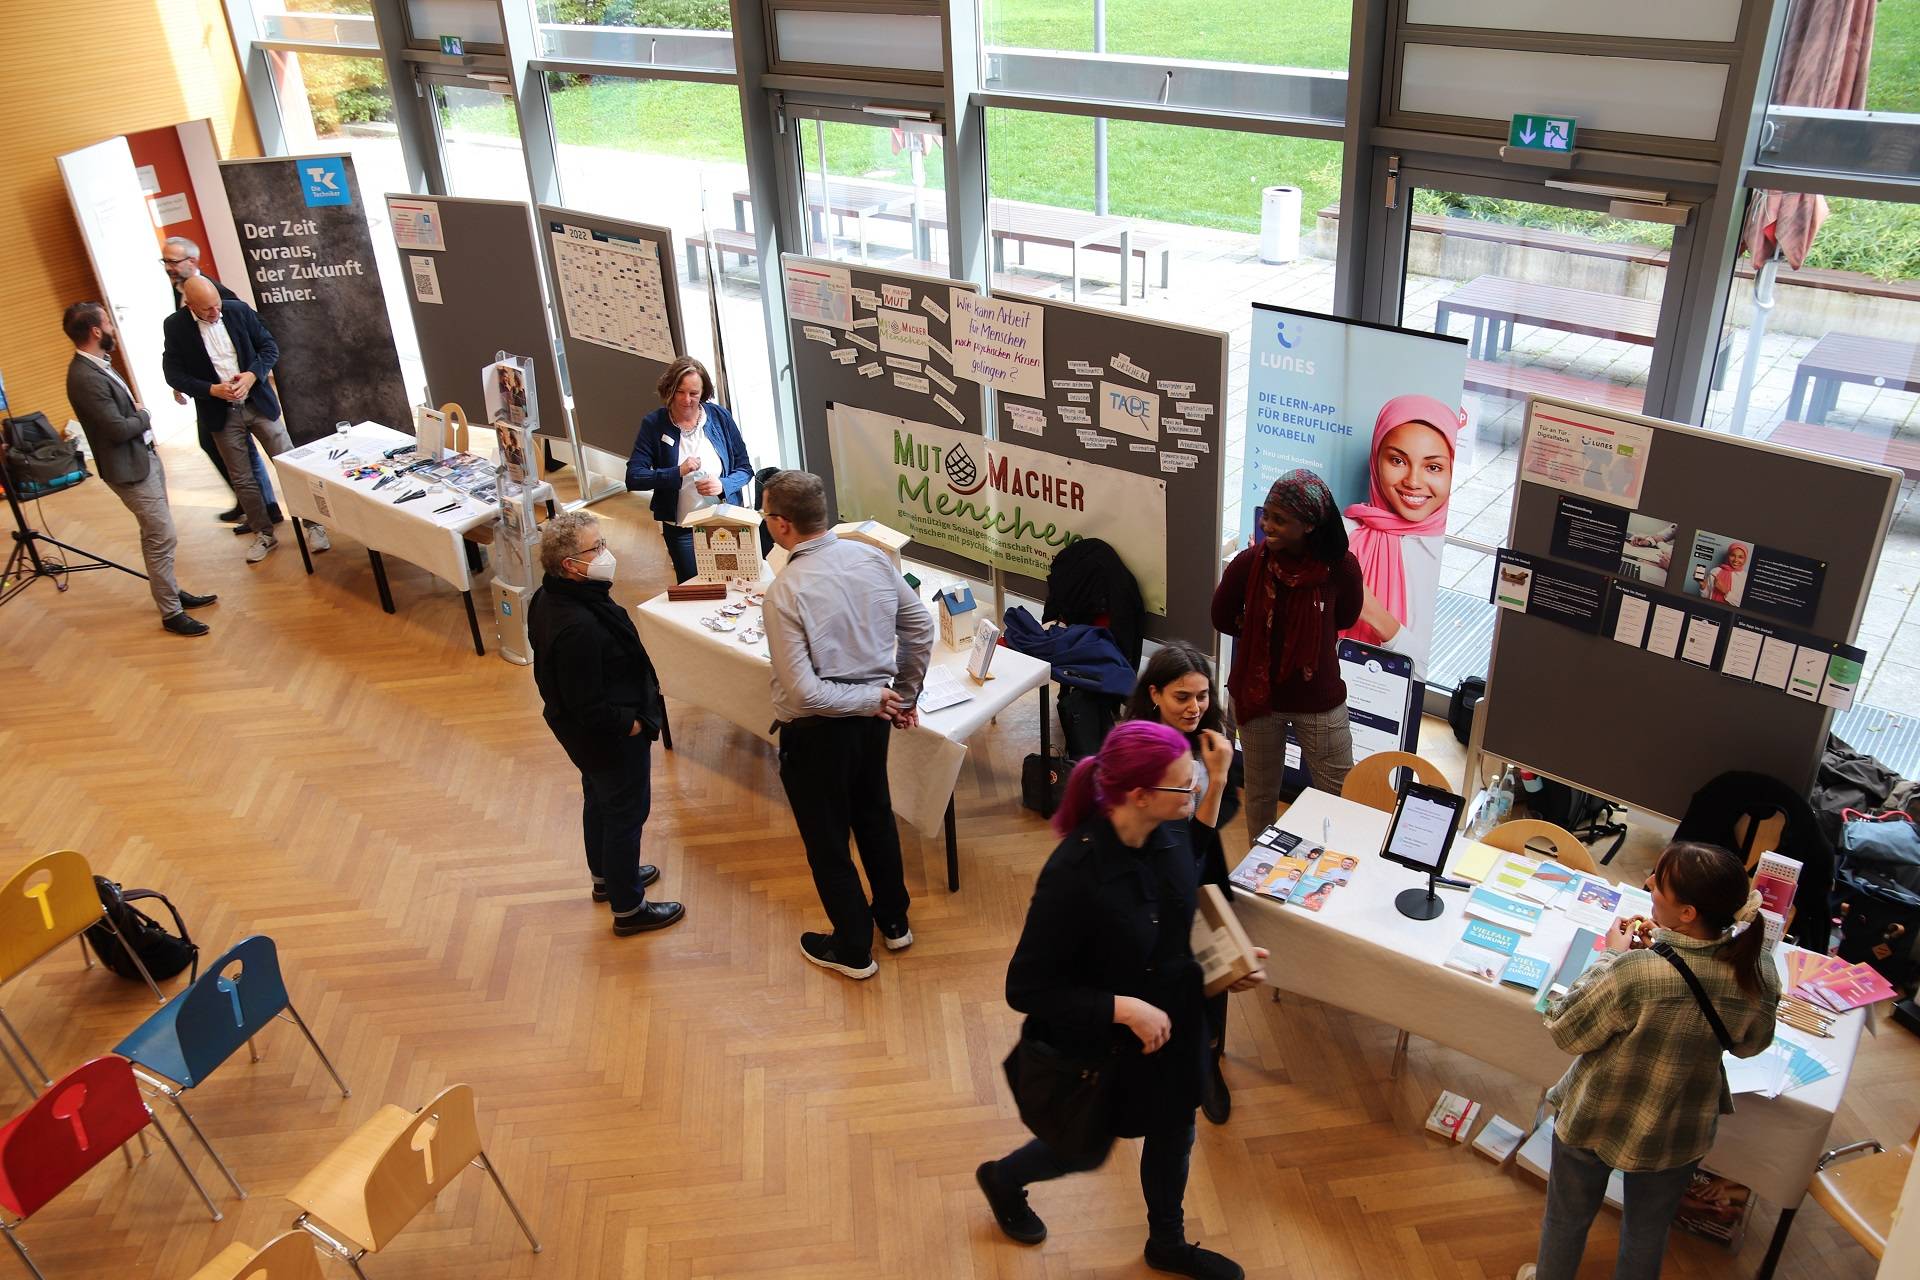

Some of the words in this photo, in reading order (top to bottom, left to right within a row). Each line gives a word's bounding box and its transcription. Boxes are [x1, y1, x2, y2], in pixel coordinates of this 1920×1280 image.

[306, 167, 339, 190] TK
[244, 222, 276, 240] Der
[280, 219, 319, 236] Zeit
[250, 245, 317, 261] voraus,
[256, 263, 284, 283] der
[289, 260, 363, 280] Zukunft
[260, 286, 316, 304] näher.
[884, 295, 905, 308] MUT
[957, 295, 972, 312] Wie
[974, 302, 995, 320] kann
[997, 307, 1031, 328] Arbeit
[879, 330, 930, 346] Menschen
[901, 322, 927, 335] MACHER
[969, 318, 979, 333] für
[981, 323, 1026, 349] Menschen
[955, 338, 971, 348] nach
[973, 342, 1010, 359] psychischen
[1014, 352, 1040, 367] Krisen
[971, 360, 1006, 382] gelingen
[1009, 367, 1019, 382] ?
[1259, 391, 1277, 404] DIE
[1280, 395, 1336, 416] LERN-APP
[1258, 407, 1280, 421] FÜR
[1282, 412, 1353, 436] BERUFLICHE
[1257, 423, 1315, 444] VOKABELN
[1537, 431, 1570, 443] Digitalfabrik
[1591, 441, 1613, 450] LUNES
[894, 430, 942, 473] MUT
[988, 452, 1084, 511] MACHER
[898, 474, 1083, 548] Menschen
[897, 509, 951, 530] gemeinnützige
[952, 523, 1033, 553] Sozialgenossenschaft
[909, 524, 946, 539] Menschen
[948, 534, 960, 543] mit
[961, 538, 1004, 560] psychischen
[1006, 552, 1051, 571] Beeinträcht
[1472, 925, 1512, 942] VIELFALT
[1478, 933, 1512, 948] ZUKUNFT
